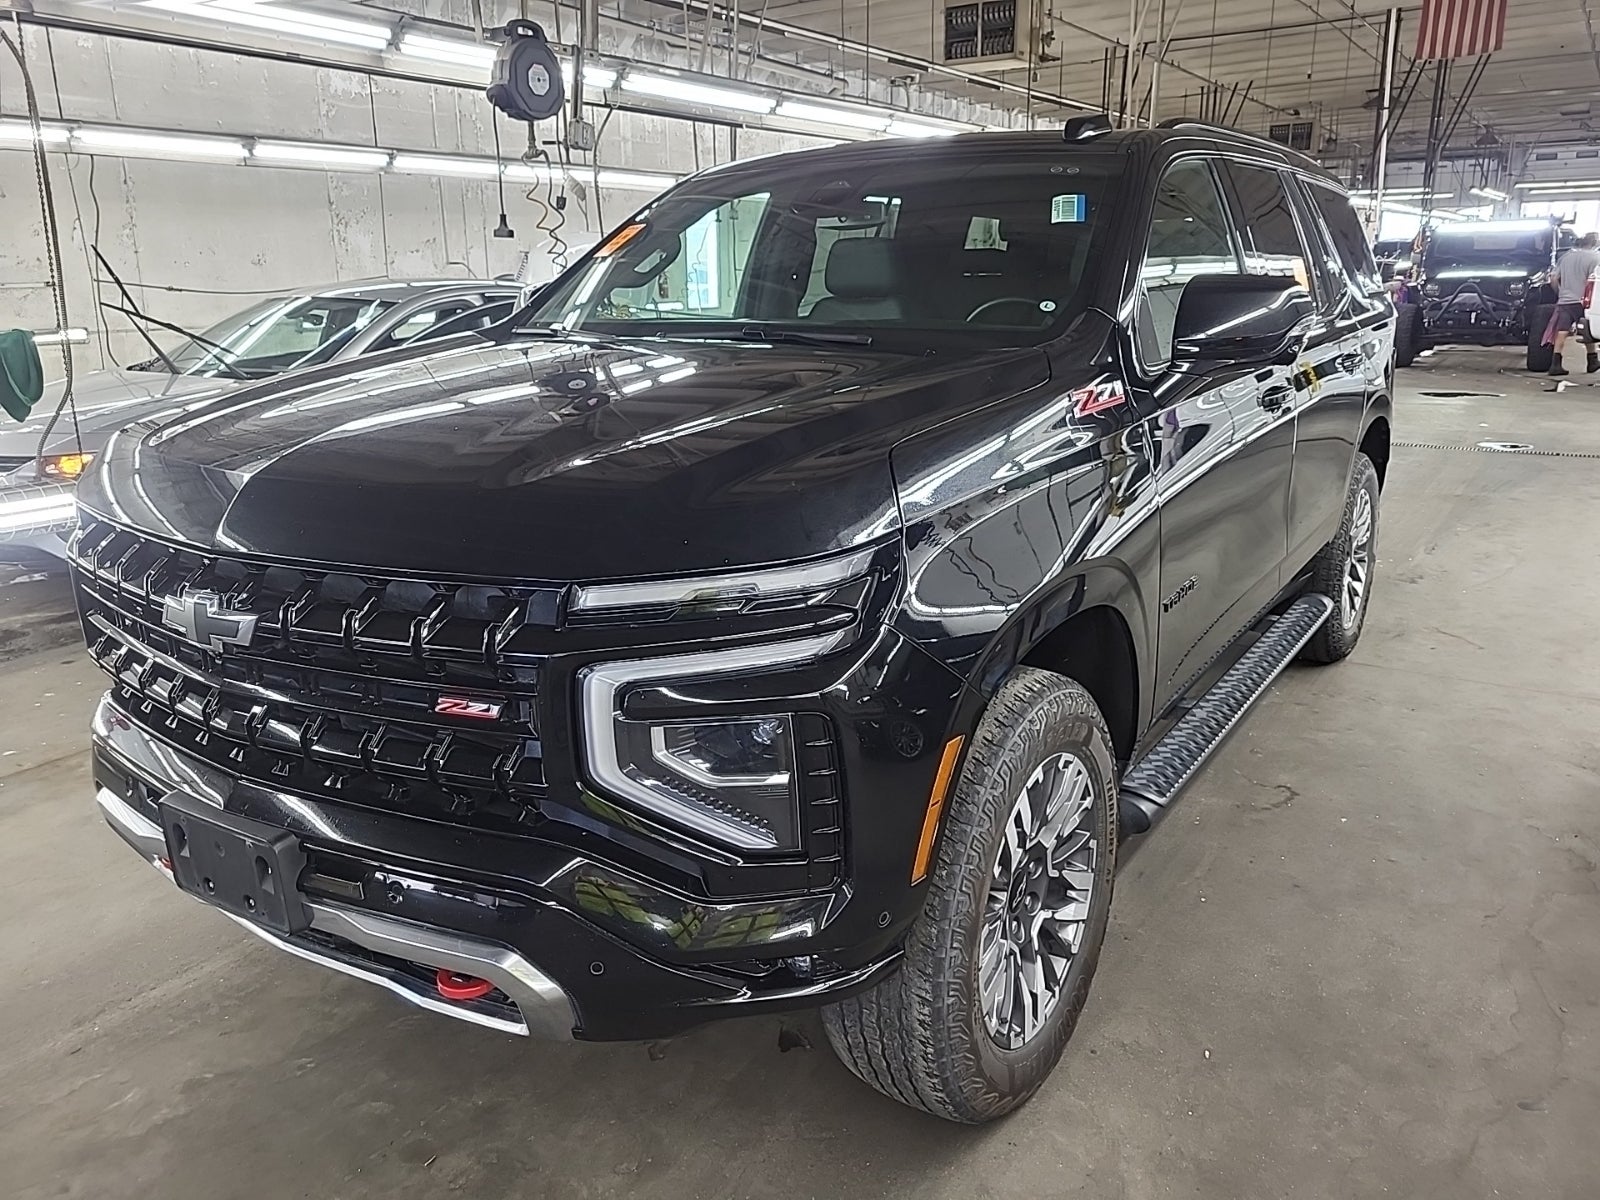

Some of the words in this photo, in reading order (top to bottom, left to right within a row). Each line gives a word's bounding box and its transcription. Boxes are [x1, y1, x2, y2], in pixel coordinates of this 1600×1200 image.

[1071, 379, 1126, 419] Z71
[1162, 575, 1199, 613] TAHOE
[434, 697, 502, 720] Z71
[1105, 777, 1116, 856] TERRITORY
